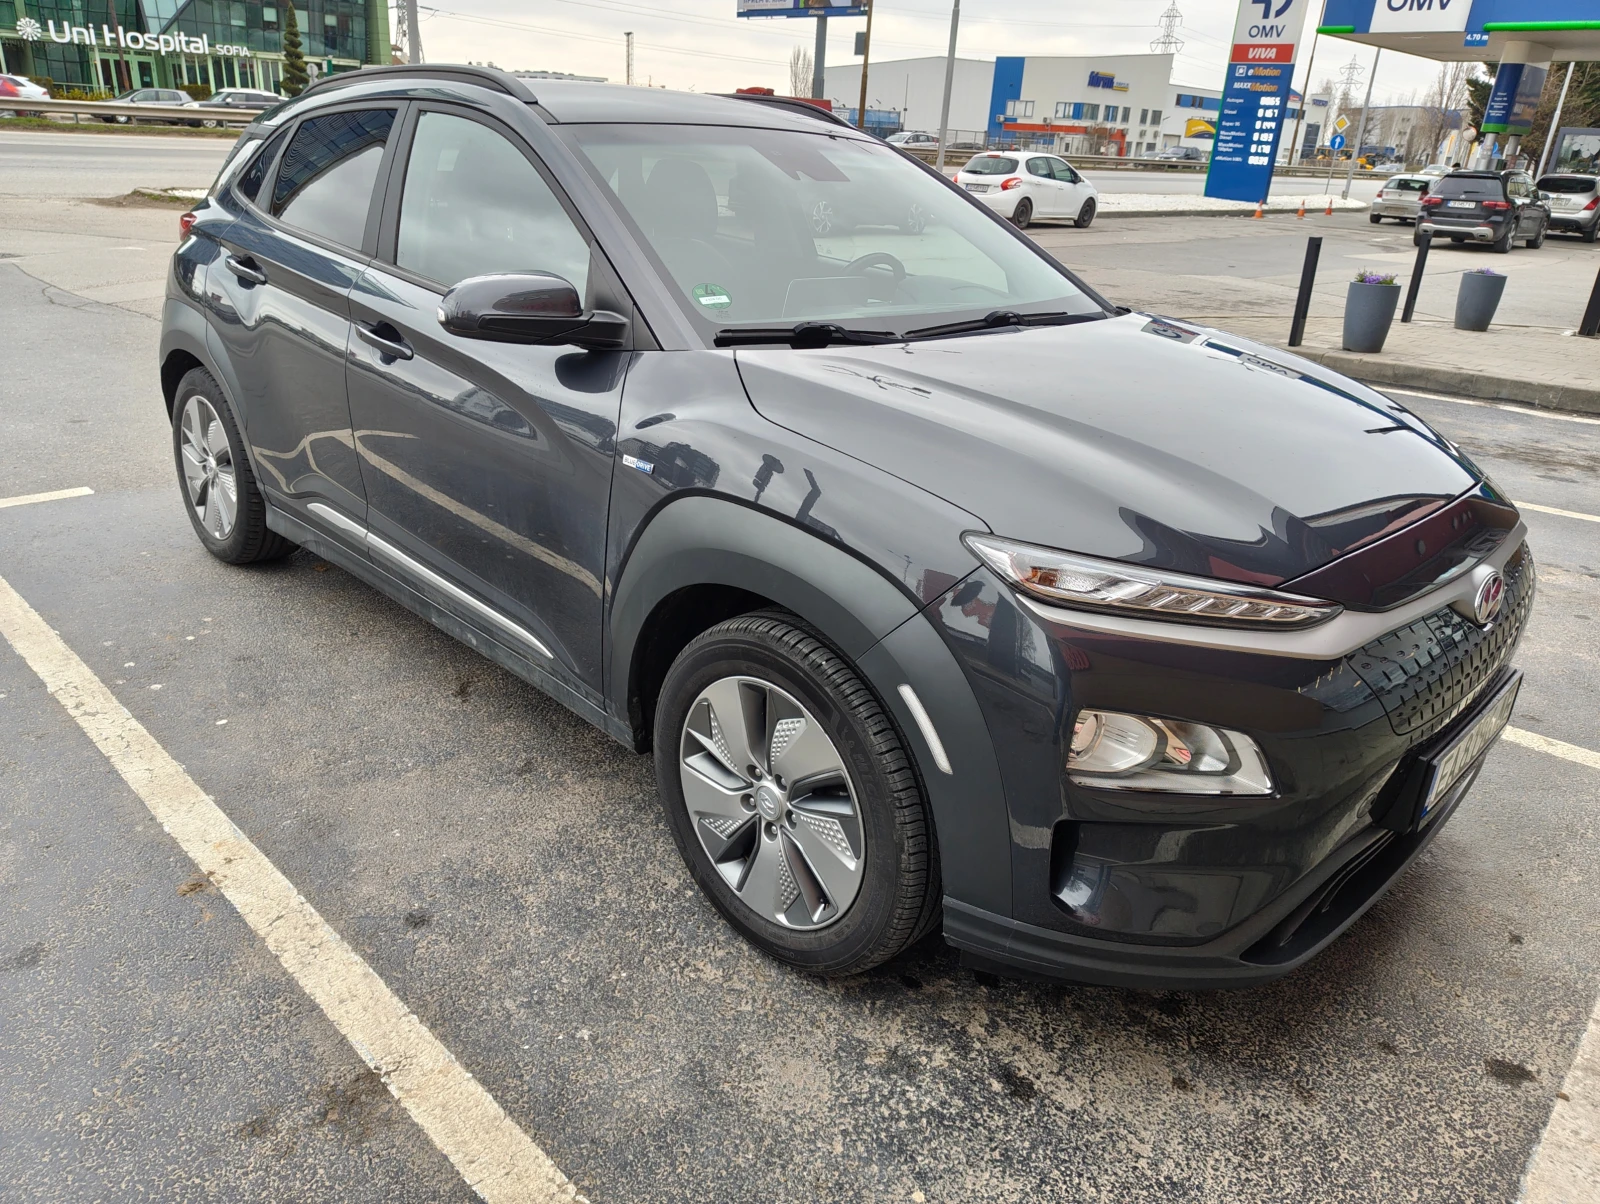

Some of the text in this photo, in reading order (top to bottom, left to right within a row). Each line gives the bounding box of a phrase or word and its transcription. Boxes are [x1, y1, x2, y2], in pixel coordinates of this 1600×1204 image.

[1248, 25, 1286, 38] OMV
[47, 20, 250, 57] Uni Hospital SOFIA
[1247, 47, 1277, 59] VIVA
[1247, 66, 1281, 76] eMotion
